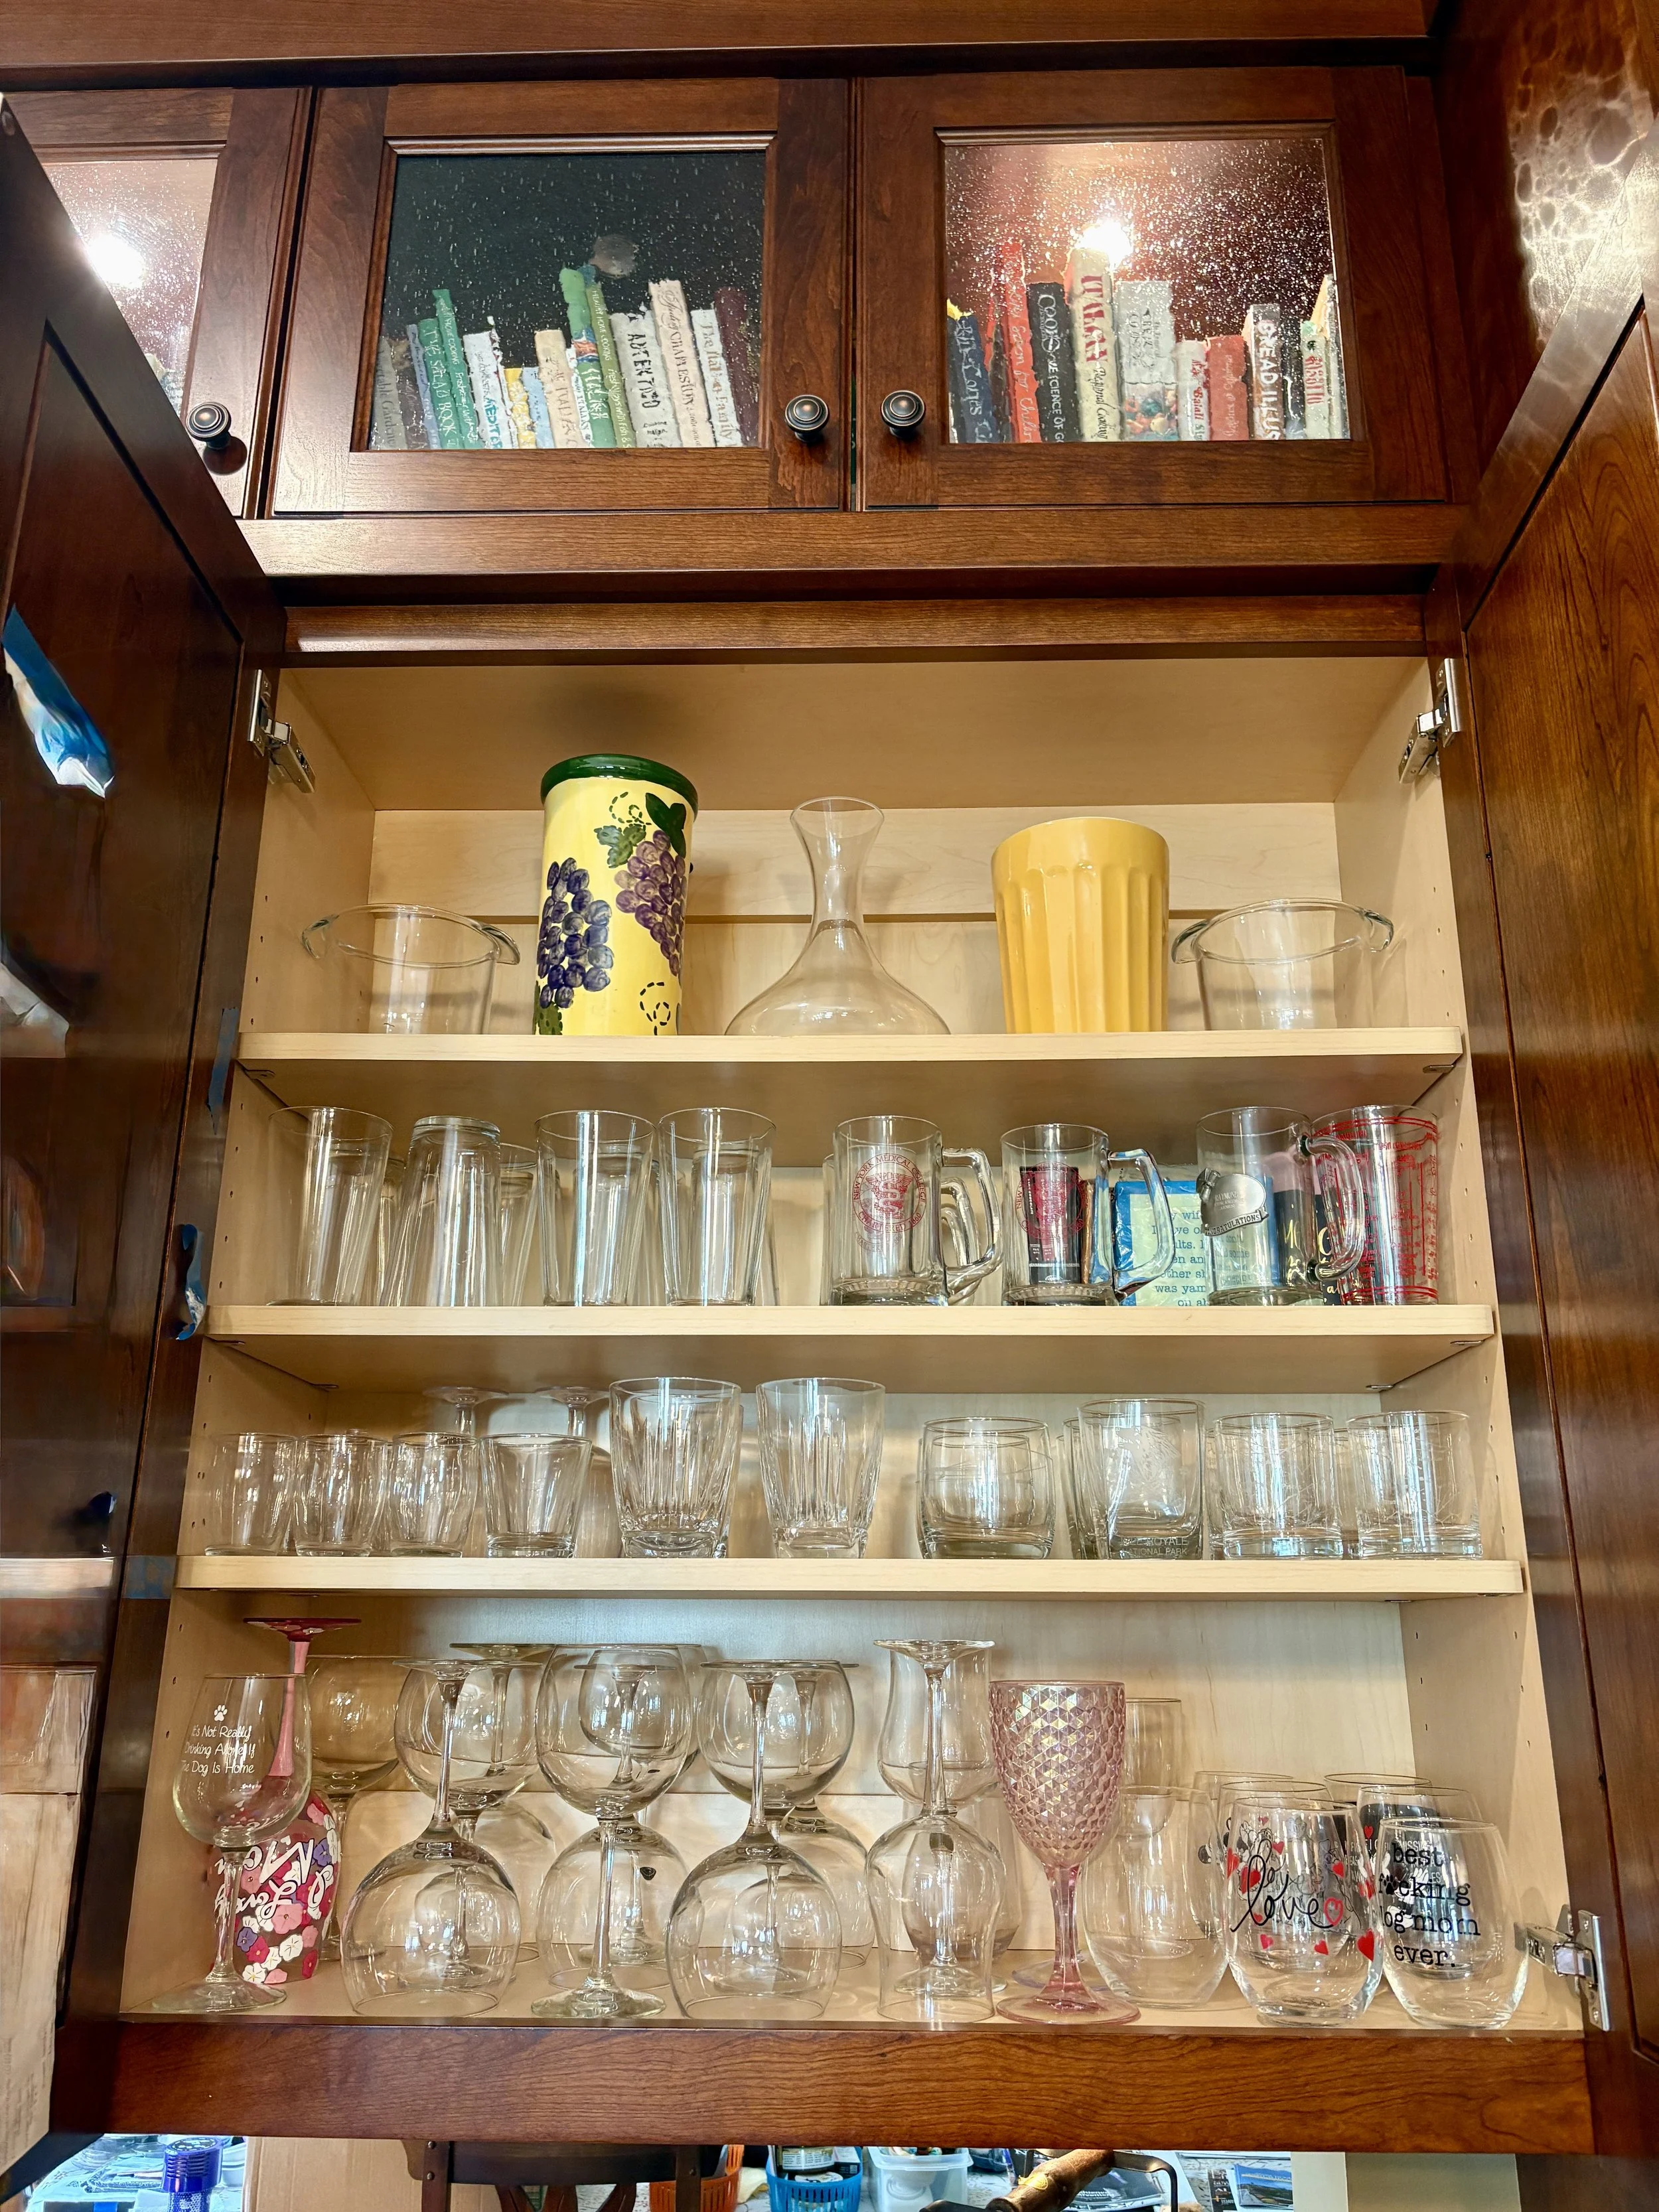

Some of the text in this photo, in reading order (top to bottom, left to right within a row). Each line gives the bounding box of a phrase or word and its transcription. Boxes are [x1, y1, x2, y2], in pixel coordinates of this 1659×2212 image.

[437, 402, 457, 437] BOOK
[716, 397, 734, 439] Family
[857, 1161, 874, 1179] YORK
[875, 1155, 910, 1168] MEDICAL
[912, 1167, 926, 1203] COLLEGE
[858, 1211, 922, 1232] CHARTERED 1860
[1155, 1285, 1177, 1293] was
[1147, 1537, 1190, 1546] ROYALE
[202, 1725, 217, 1737] Not
[219, 1725, 252, 1742] Really
[184, 1741, 256, 1759] Drinking Alone If
[191, 1760, 209, 1777] Dog
[212, 1761, 221, 1774] Is
[225, 1759, 255, 1774] Home
[1392, 1842, 1444, 1867] best
[1230, 1855, 1334, 1932] love
[1379, 1873, 1471, 1907] fcking
[1411, 1914, 1481, 1936] mom
[1394, 1945, 1456, 1968] ever.
